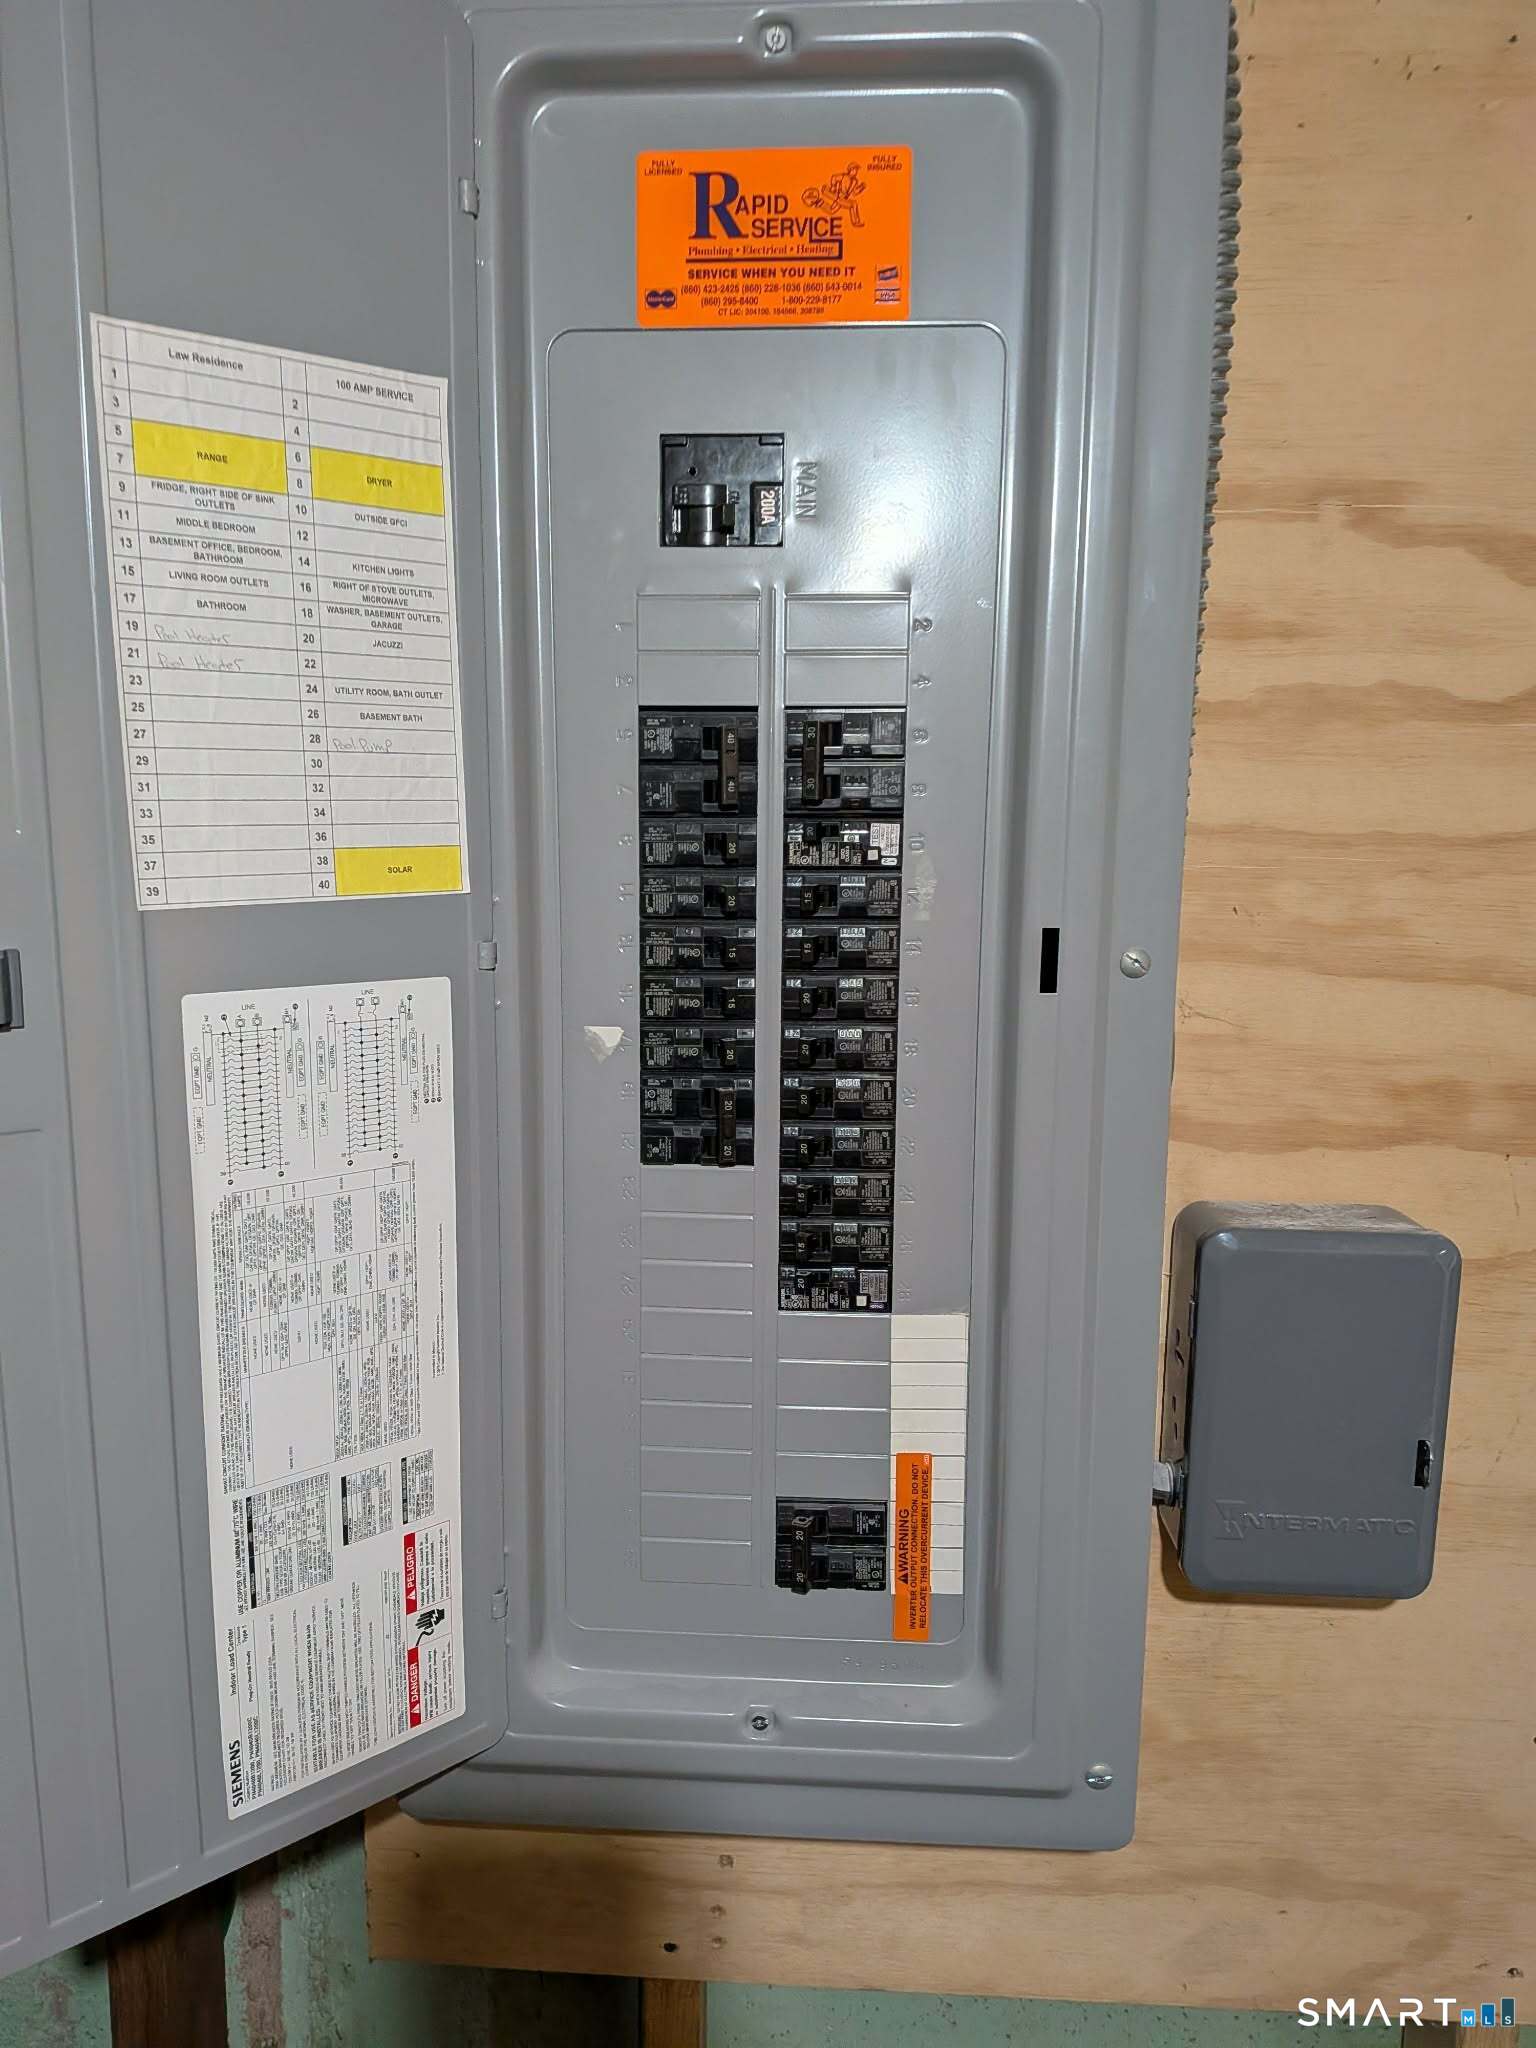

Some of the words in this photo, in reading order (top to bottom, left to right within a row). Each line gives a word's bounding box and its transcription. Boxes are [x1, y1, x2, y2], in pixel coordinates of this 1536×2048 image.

[688, 171, 788, 239] RAPID
[752, 217, 842, 239] SERVICE
[688, 246, 734, 257] Plumbing
[743, 246, 787, 256] Electrical
[797, 244, 834, 256] Heating
[688, 268, 737, 279] SERVICE
[742, 268, 776, 279] WHEN
[780, 267, 805, 278] YOU
[809, 267, 841, 277] NEED
[845, 266, 856, 276] IT
[169, 347, 190, 362] Law
[192, 351, 244, 371] Residence
[111, 368, 117, 378] 1
[336, 379, 351, 391] 100
[353, 382, 373, 395] AMP
[375, 387, 414, 403] SERVICE
[113, 396, 120, 407] 3
[292, 399, 298, 410] 2
[115, 425, 122, 436] 5
[294, 426, 300, 436] 4
[117, 452, 124, 464] 7
[197, 450, 229, 464] RANGE
[295, 453, 301, 463] 6
[118, 481, 126, 492] 9
[296, 479, 303, 489] 8
[366, 475, 393, 487] DRYER
[151, 480, 188, 495] FRIDGE,
[189, 485, 217, 497] RIGHT
[219, 489, 239, 501] SIDE
[241, 492, 253, 502] OF
[255, 493, 276, 505] SINK
[797, 461, 817, 519] MAIN
[195, 499, 236, 512] OUTLETS
[296, 505, 307, 515] 10
[761, 489, 776, 525] 200A
[117, 509, 130, 521] 11
[354, 513, 387, 525] OUTSIDE
[389, 517, 408, 528] GFCI
[176, 517, 209, 529] MIDDLE
[212, 520, 256, 534] BEDROOM
[296, 531, 309, 541] 12
[119, 537, 133, 548] 13
[149, 536, 199, 549] BASEMENT
[201, 539, 236, 554] OFFICE,
[237, 544, 283, 558] BEDROOM,
[193, 552, 244, 565] BATHROOM
[298, 557, 310, 567] 14
[121, 565, 135, 576] 15
[352, 563, 386, 575] KITCHEN
[388, 567, 415, 577] LIGHTS
[168, 570, 199, 581] LIVING
[200, 573, 228, 584] ROOM
[230, 575, 269, 588] OUTLETS
[300, 582, 312, 593] 16
[333, 582, 356, 592] RIGHT
[359, 583, 370, 592] OF
[371, 584, 397, 595] STOVE
[398, 587, 435, 600] OUTLETS,
[123, 592, 136, 603] 17
[362, 595, 408, 607] MICROWAVE
[196, 599, 247, 611] BATHROOM
[302, 608, 313, 618] 18
[327, 606, 363, 617] WASHER,
[364, 609, 405, 620] BASEMENT
[407, 613, 443, 624] OUTLETS,
[125, 620, 139, 631] 19
[371, 620, 402, 631] GARAGE
[912, 617, 933, 633] 2
[303, 633, 315, 644] 20
[372, 639, 403, 649] JACUZZI
[127, 647, 140, 658] 21
[304, 659, 316, 669] 22
[129, 675, 142, 686] 23
[306, 684, 318, 694] 24
[335, 687, 364, 697] UTILITY
[366, 688, 391, 698] ROOM,
[392, 689, 413, 698] BATH
[414, 691, 443, 700] OUTLET
[131, 702, 145, 713] 25
[307, 709, 319, 719] 26
[360, 711, 401, 722] BASEMENT
[402, 713, 423, 722] BATH
[133, 729, 146, 739] 27
[807, 726, 816, 739] 30
[309, 734, 321, 744] 28
[727, 732, 735, 745] 40
[332, 737, 355, 752] Pool
[359, 738, 392, 753] Pump
[136, 755, 149, 766] 29
[311, 758, 323, 768] 30
[138, 782, 151, 793] 31
[312, 783, 324, 793] 32
[727, 781, 735, 792] 40
[807, 777, 815, 790] 30
[139, 808, 153, 819] 33
[314, 807, 326, 817] 34
[315, 832, 327, 841] 36
[871, 822, 879, 844] TEST
[142, 835, 155, 845] 35
[728, 842, 736, 855] 20
[144, 861, 157, 871] 37
[317, 856, 329, 866] 38
[387, 865, 413, 875] SOLAR
[318, 880, 330, 889] 40
[146, 887, 160, 897] 39
[804, 892, 812, 902] 15
[728, 895, 736, 907] 20
[728, 948, 736, 958] 15
[804, 943, 812, 954] 15
[728, 998, 736, 1009] 15
[803, 992, 811, 1004] 20
[726, 1049, 734, 1060] 20
[801, 1043, 809, 1055] 20
[800, 1094, 808, 1105] 20
[724, 1100, 732, 1111] 20
[724, 1145, 732, 1156] 20
[800, 1143, 808, 1154] 20
[798, 1193, 805, 1202] 15
[798, 1242, 805, 1252] 15
[797, 1278, 805, 1289] 20
[912, 1485, 919, 1495] DO
[1214, 1499, 1418, 1541] INTERMATIC
[796, 1530, 804, 1540] 20
[898, 1508, 910, 1572] WARNING
[406, 1546, 415, 1588] PELIGRO
[797, 1572, 804, 1582] 20
[909, 1590, 917, 1630] INVERTER
[919, 1585, 927, 1629] RELOCATE
[409, 1662, 418, 1702] DANGER
[229, 1739, 244, 1808] SIEMENS
